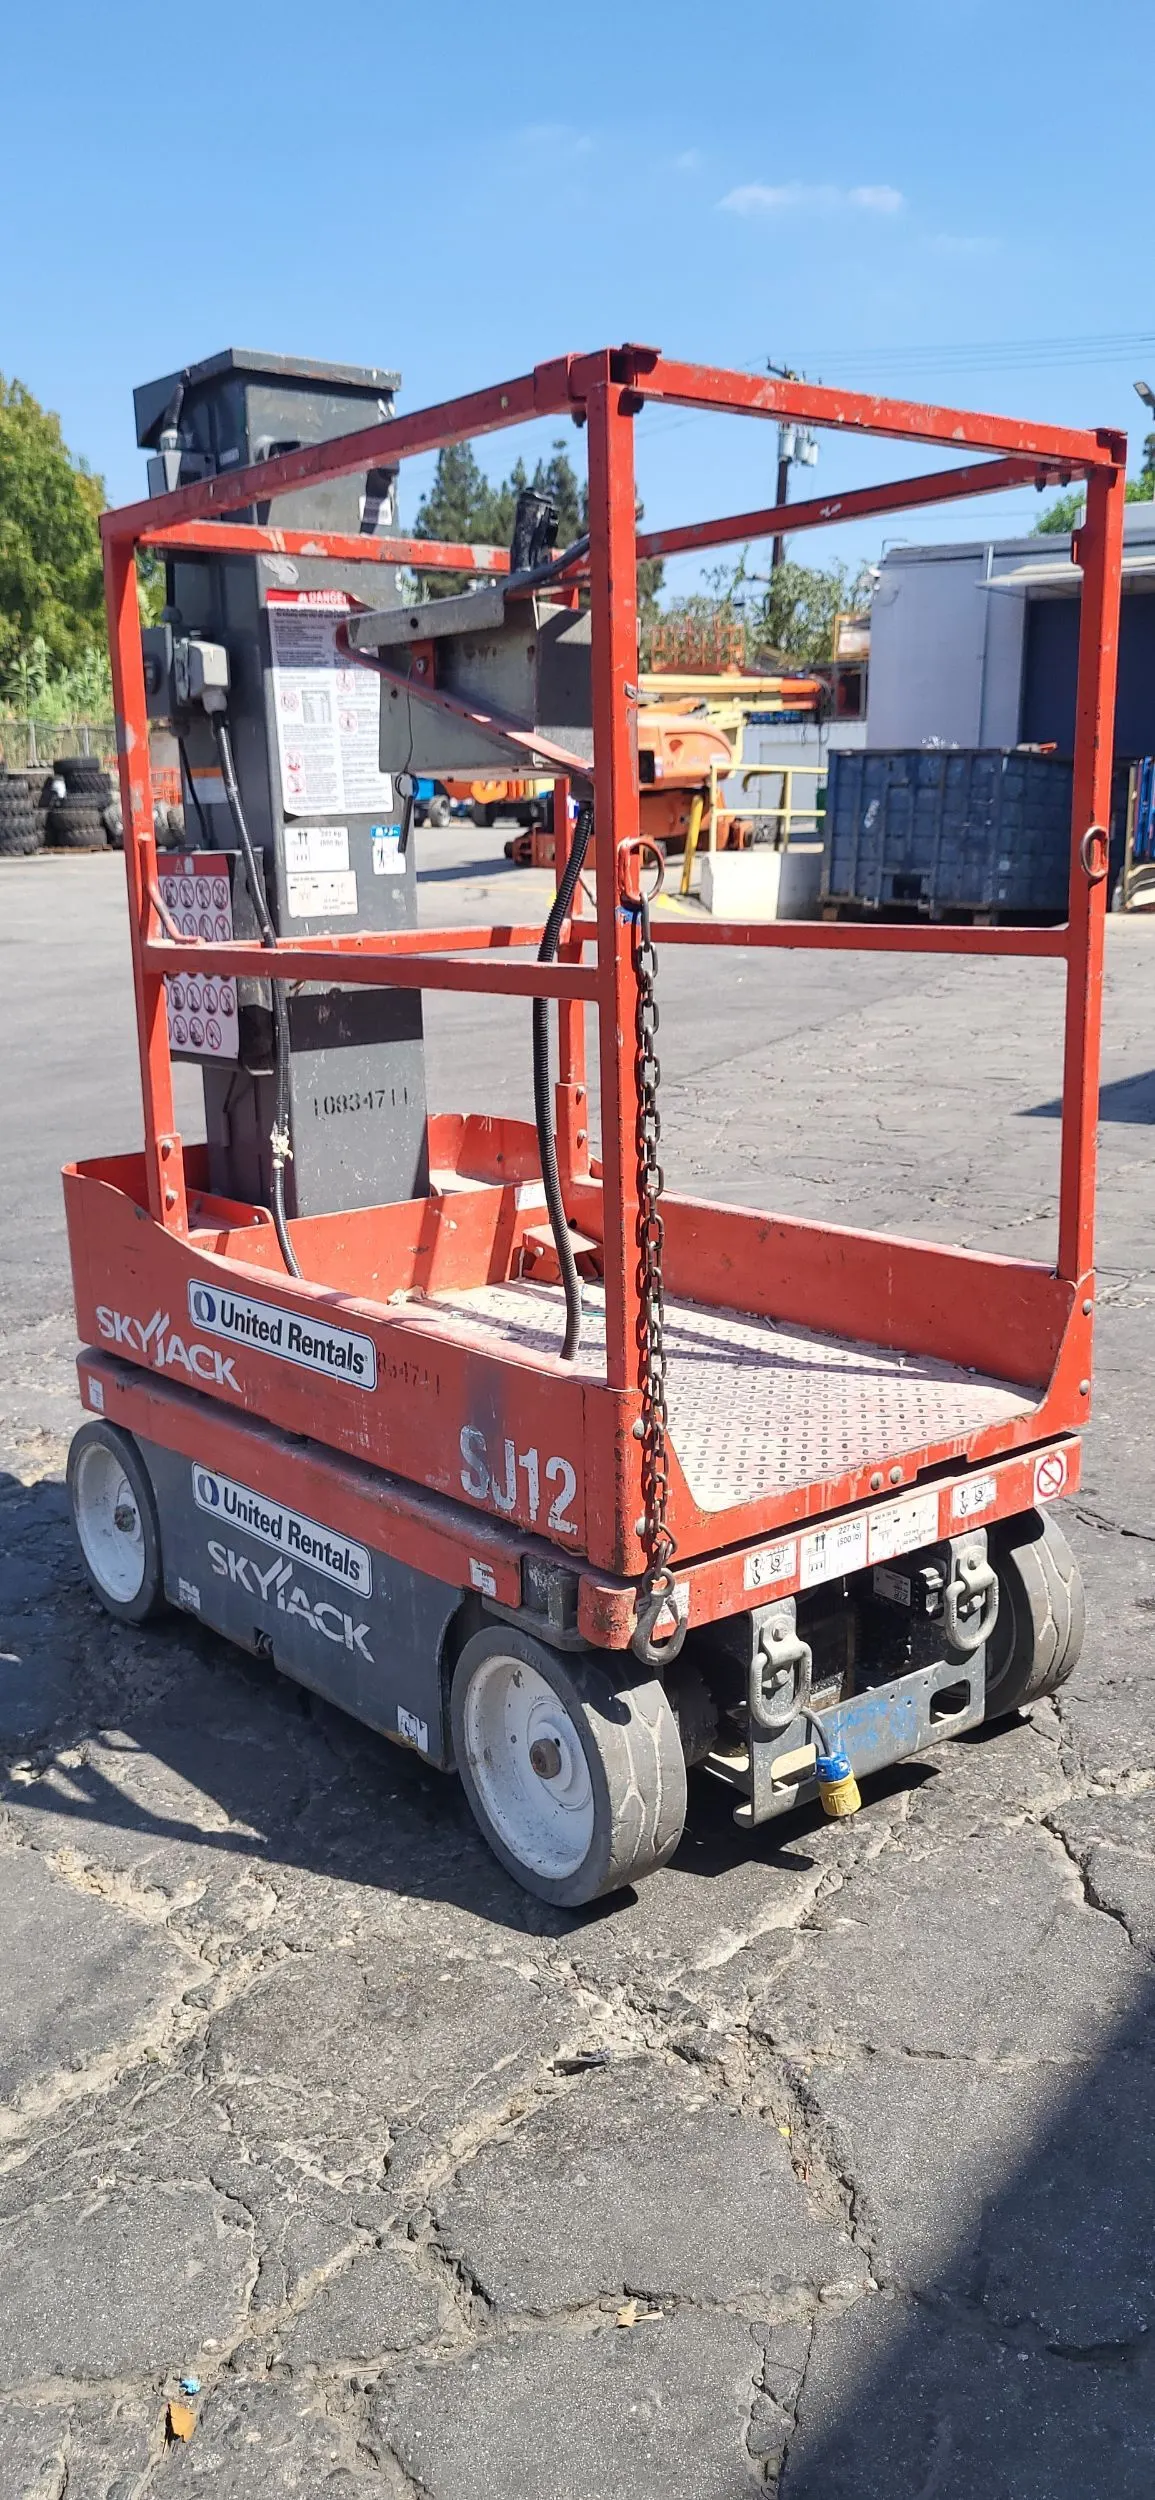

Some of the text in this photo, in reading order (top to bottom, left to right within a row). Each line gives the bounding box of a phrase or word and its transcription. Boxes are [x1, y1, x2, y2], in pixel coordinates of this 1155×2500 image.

[95, 1306, 243, 1393] SKYJACK
[220, 1302, 365, 1376] United Rentals
[460, 1424, 578, 1536] SJ12
[223, 1487, 361, 1581] United Rentals
[838, 1524, 851, 1535] 227
[207, 1540, 375, 1664] SKYJACK
